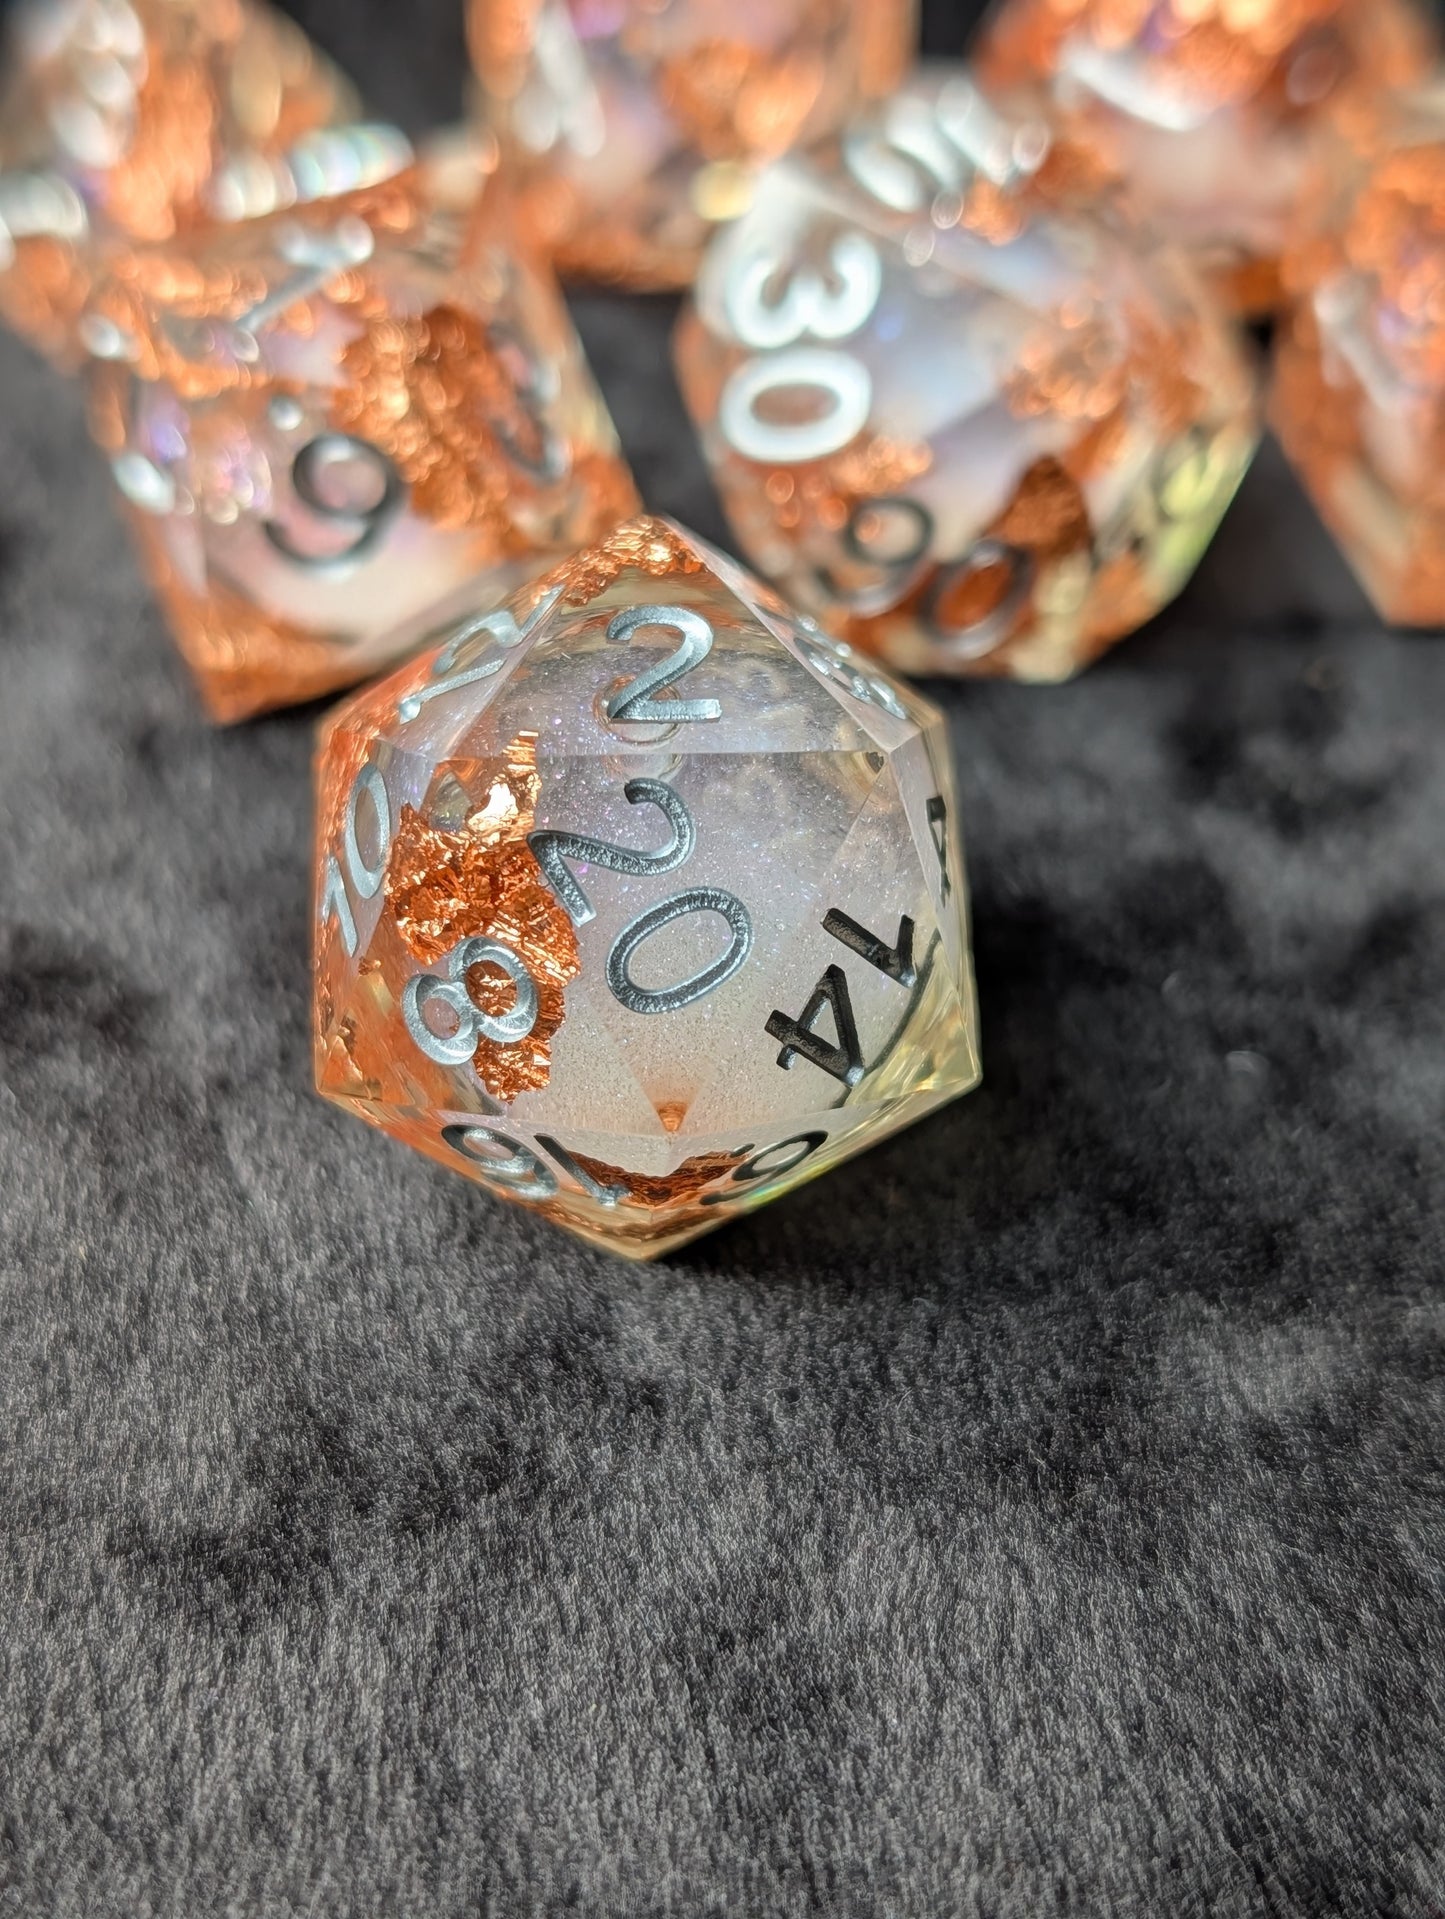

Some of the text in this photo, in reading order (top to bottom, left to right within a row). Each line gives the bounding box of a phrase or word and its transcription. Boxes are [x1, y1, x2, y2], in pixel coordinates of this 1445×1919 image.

[720, 233, 881, 462] 30
[606, 604, 721, 722] 2
[322, 763, 391, 957] 10
[527, 777, 752, 1014] 20
[402, 936, 539, 1065] 8
[763, 908, 917, 1087] 14
